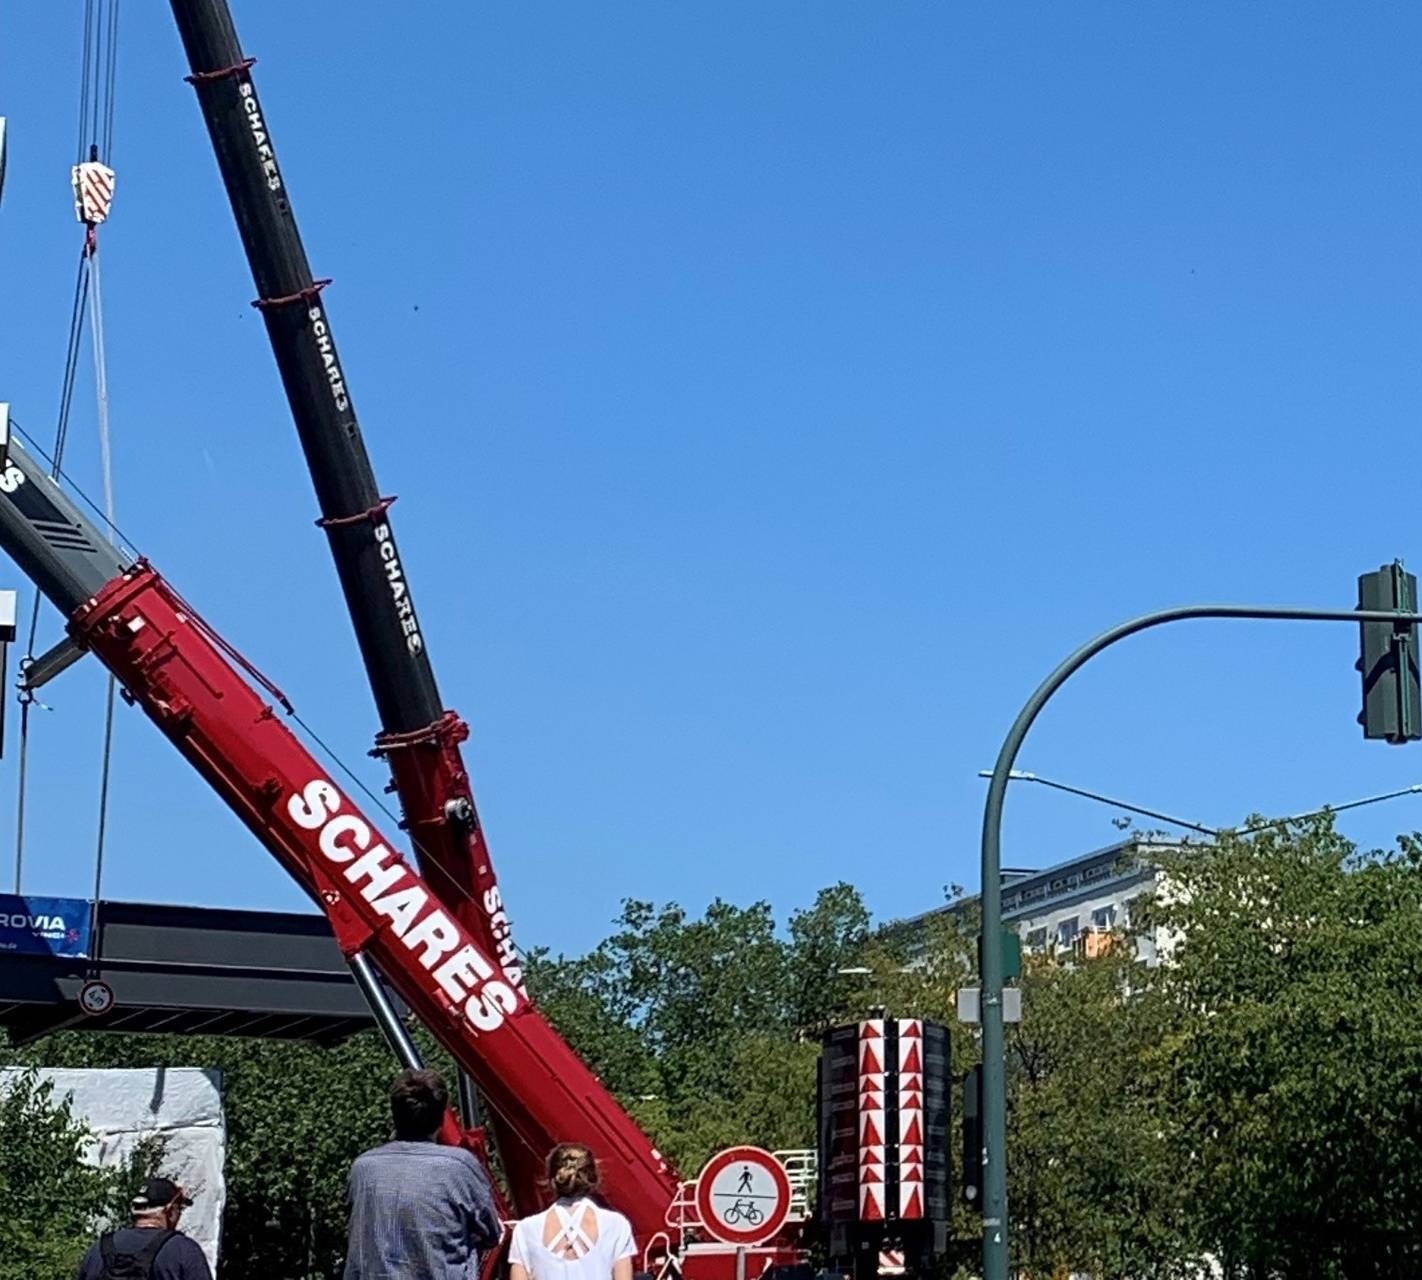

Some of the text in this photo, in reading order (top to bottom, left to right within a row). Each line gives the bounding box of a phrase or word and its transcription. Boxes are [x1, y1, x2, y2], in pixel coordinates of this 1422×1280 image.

[309, 307, 349, 412] SCHARES
[375, 523, 422, 656] SCHARES
[288, 779, 518, 1031] SCHARES
[483, 885, 530, 1001] SCHA
